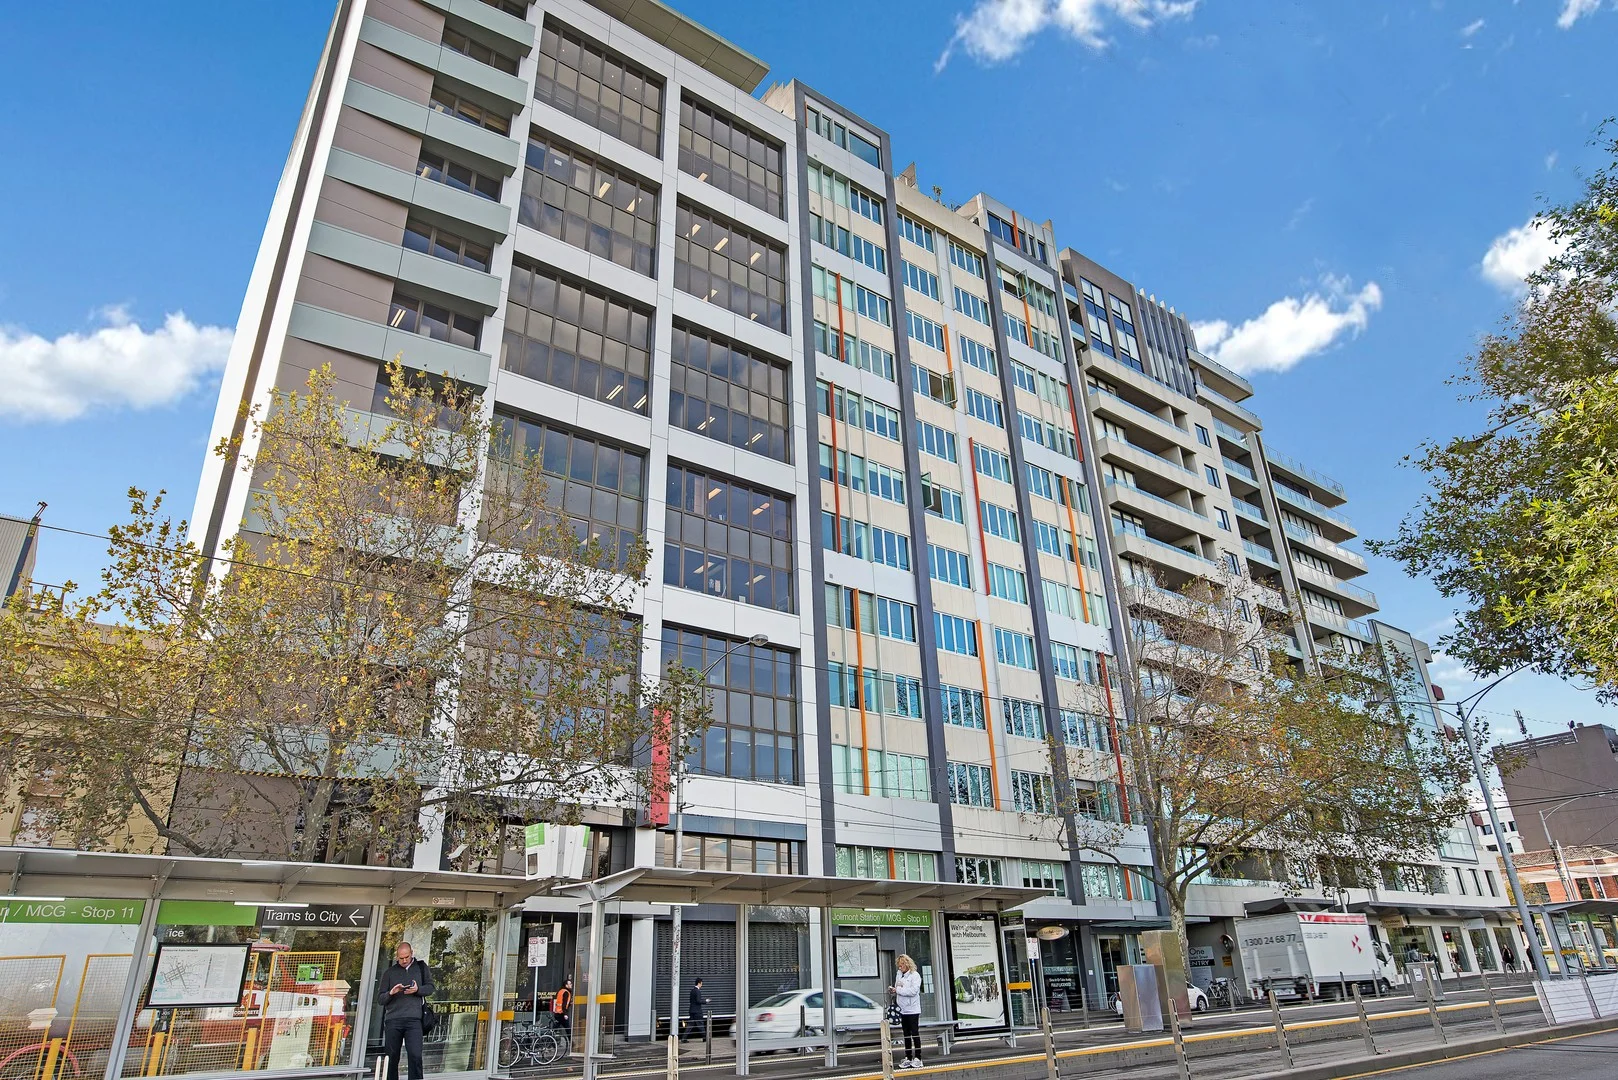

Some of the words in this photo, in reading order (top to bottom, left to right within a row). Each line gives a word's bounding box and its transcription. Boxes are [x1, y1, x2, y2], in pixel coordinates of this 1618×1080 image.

[26, 905, 66, 917] MCG
[82, 906, 115, 920] Stop
[121, 907, 134, 918] 11
[266, 910, 301, 921] Trams
[305, 912, 316, 922] to
[319, 910, 342, 924] City
[832, 913, 858, 921] Jolimont
[860, 913, 880, 922] Station
[886, 914, 901, 922] MCG
[907, 915, 920, 923] Stop
[1244, 938, 1263, 946] 1300
[1264, 937, 1274, 945] 24
[1275, 935, 1285, 943] 68
[1286, 934, 1296, 942] 77
[432, 1004, 447, 1013] Da
[450, 1003, 484, 1013] Bruno
